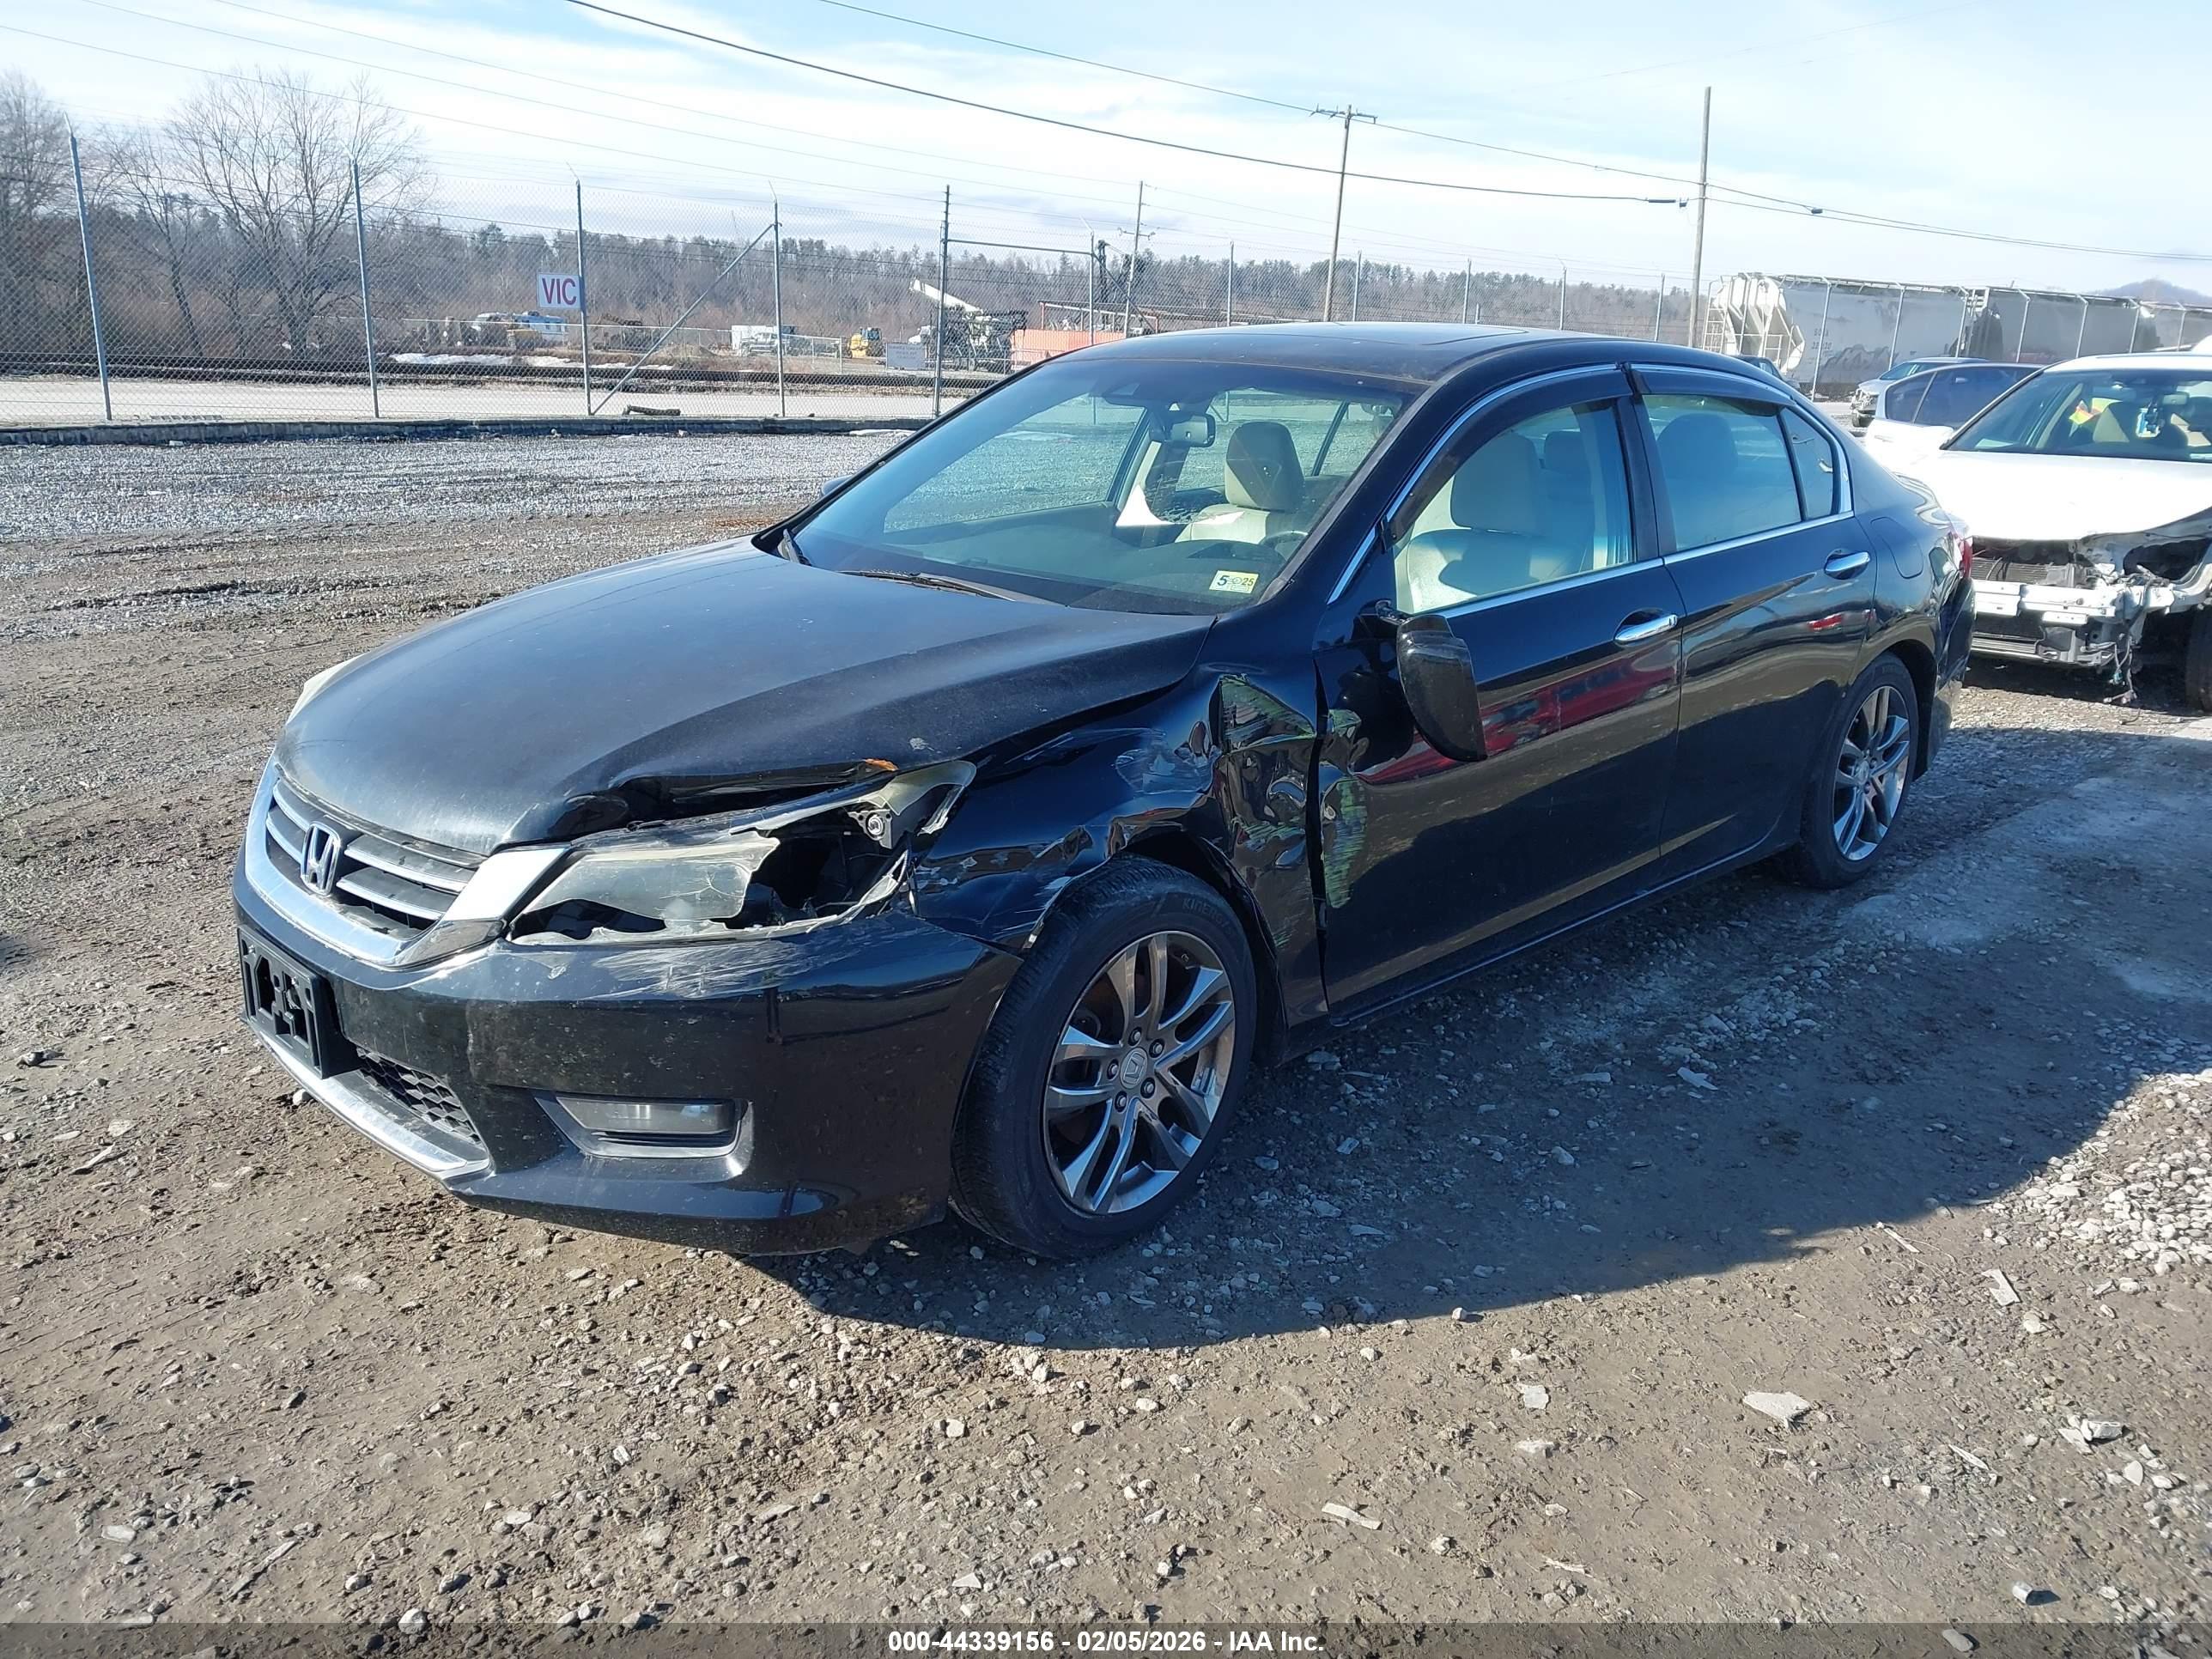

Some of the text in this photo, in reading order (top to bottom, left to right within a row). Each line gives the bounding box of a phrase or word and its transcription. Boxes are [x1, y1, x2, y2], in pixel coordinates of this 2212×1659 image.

[541, 277, 577, 306] VIC
[1217, 574, 1255, 586] 5 25
